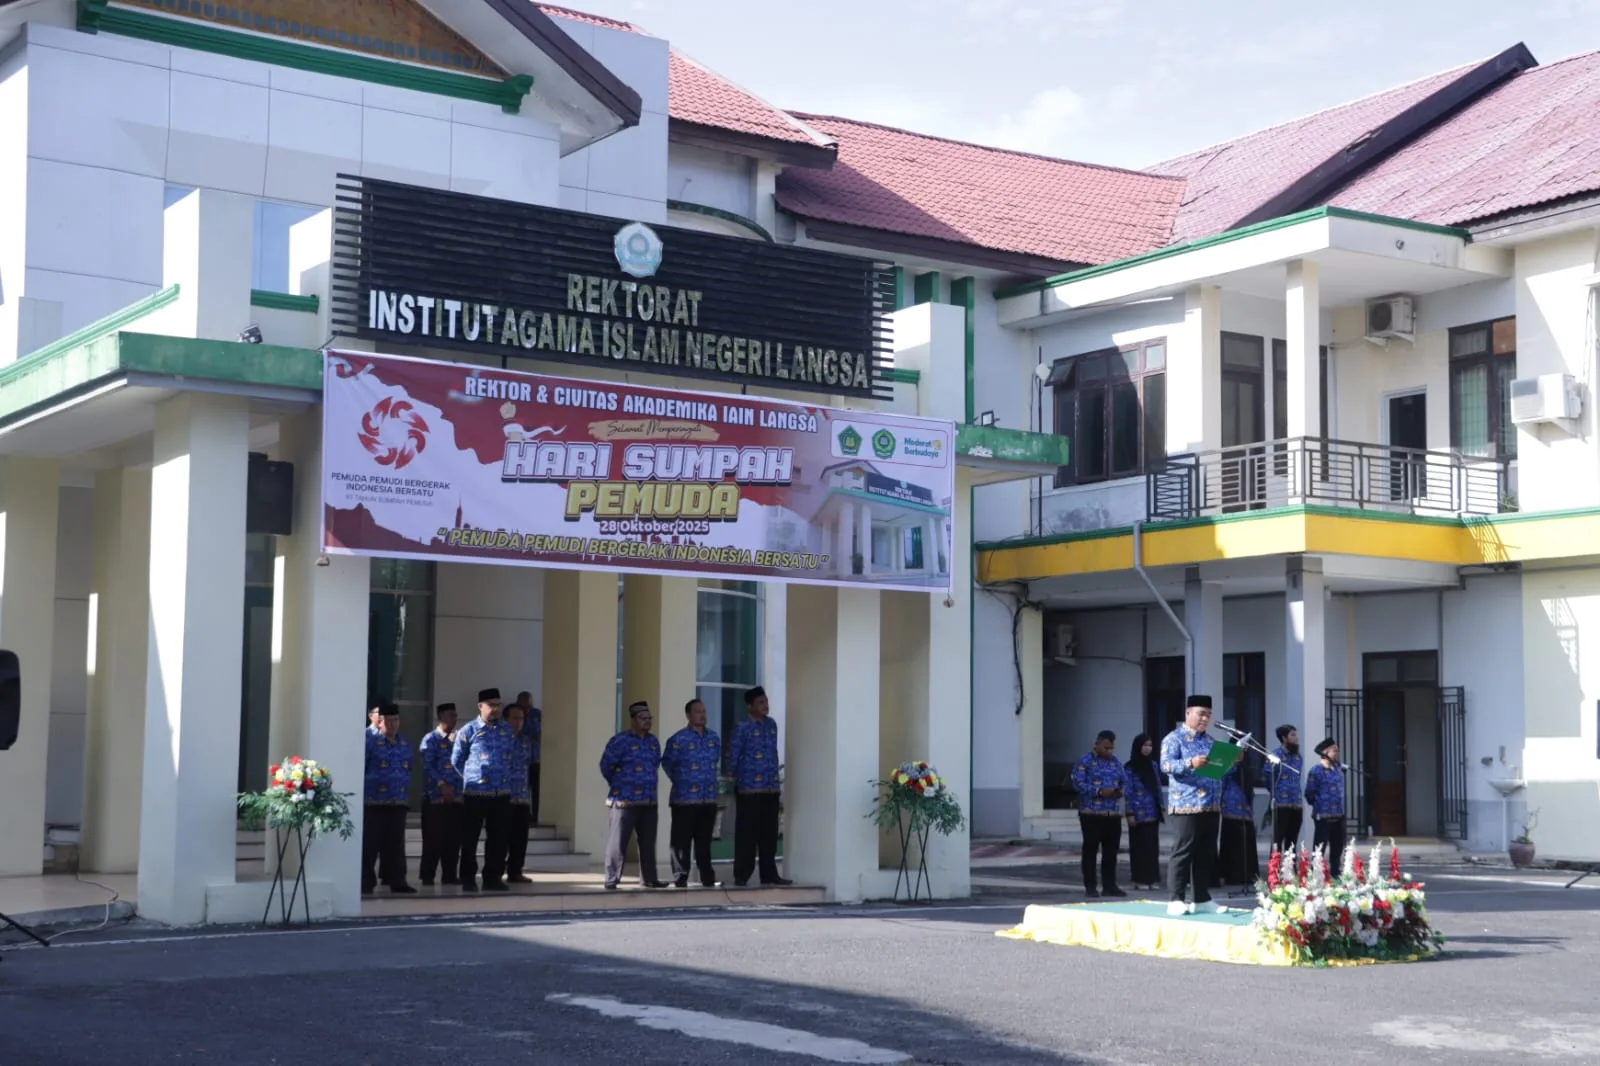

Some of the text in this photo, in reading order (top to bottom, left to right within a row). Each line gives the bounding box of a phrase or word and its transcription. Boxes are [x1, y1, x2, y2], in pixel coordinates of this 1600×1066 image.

[567, 273, 703, 327] REKTORAT
[369, 289, 868, 389] INSTITUT AGAMA ISLAM NEGERI LANGSA
[465, 376, 532, 402] REKTOR
[536, 385, 548, 404] &
[623, 394, 718, 422] AKADEMIKA
[723, 405, 754, 426] IAIN
[760, 409, 818, 433] LANGSA
[331, 472, 451, 490] PEMUDA PEMUDI BERGERAK
[501, 440, 795, 487] HARI SUMPAH
[345, 483, 434, 497] INDONESIA BERSATU
[564, 480, 740, 523] PEMUDA
[523, 533, 586, 554] PEMUDI
[588, 538, 670, 560] BERGERAK
[671, 545, 751, 565] INDONESIA
[600, 520, 710, 535] 28 Oktober 2025
